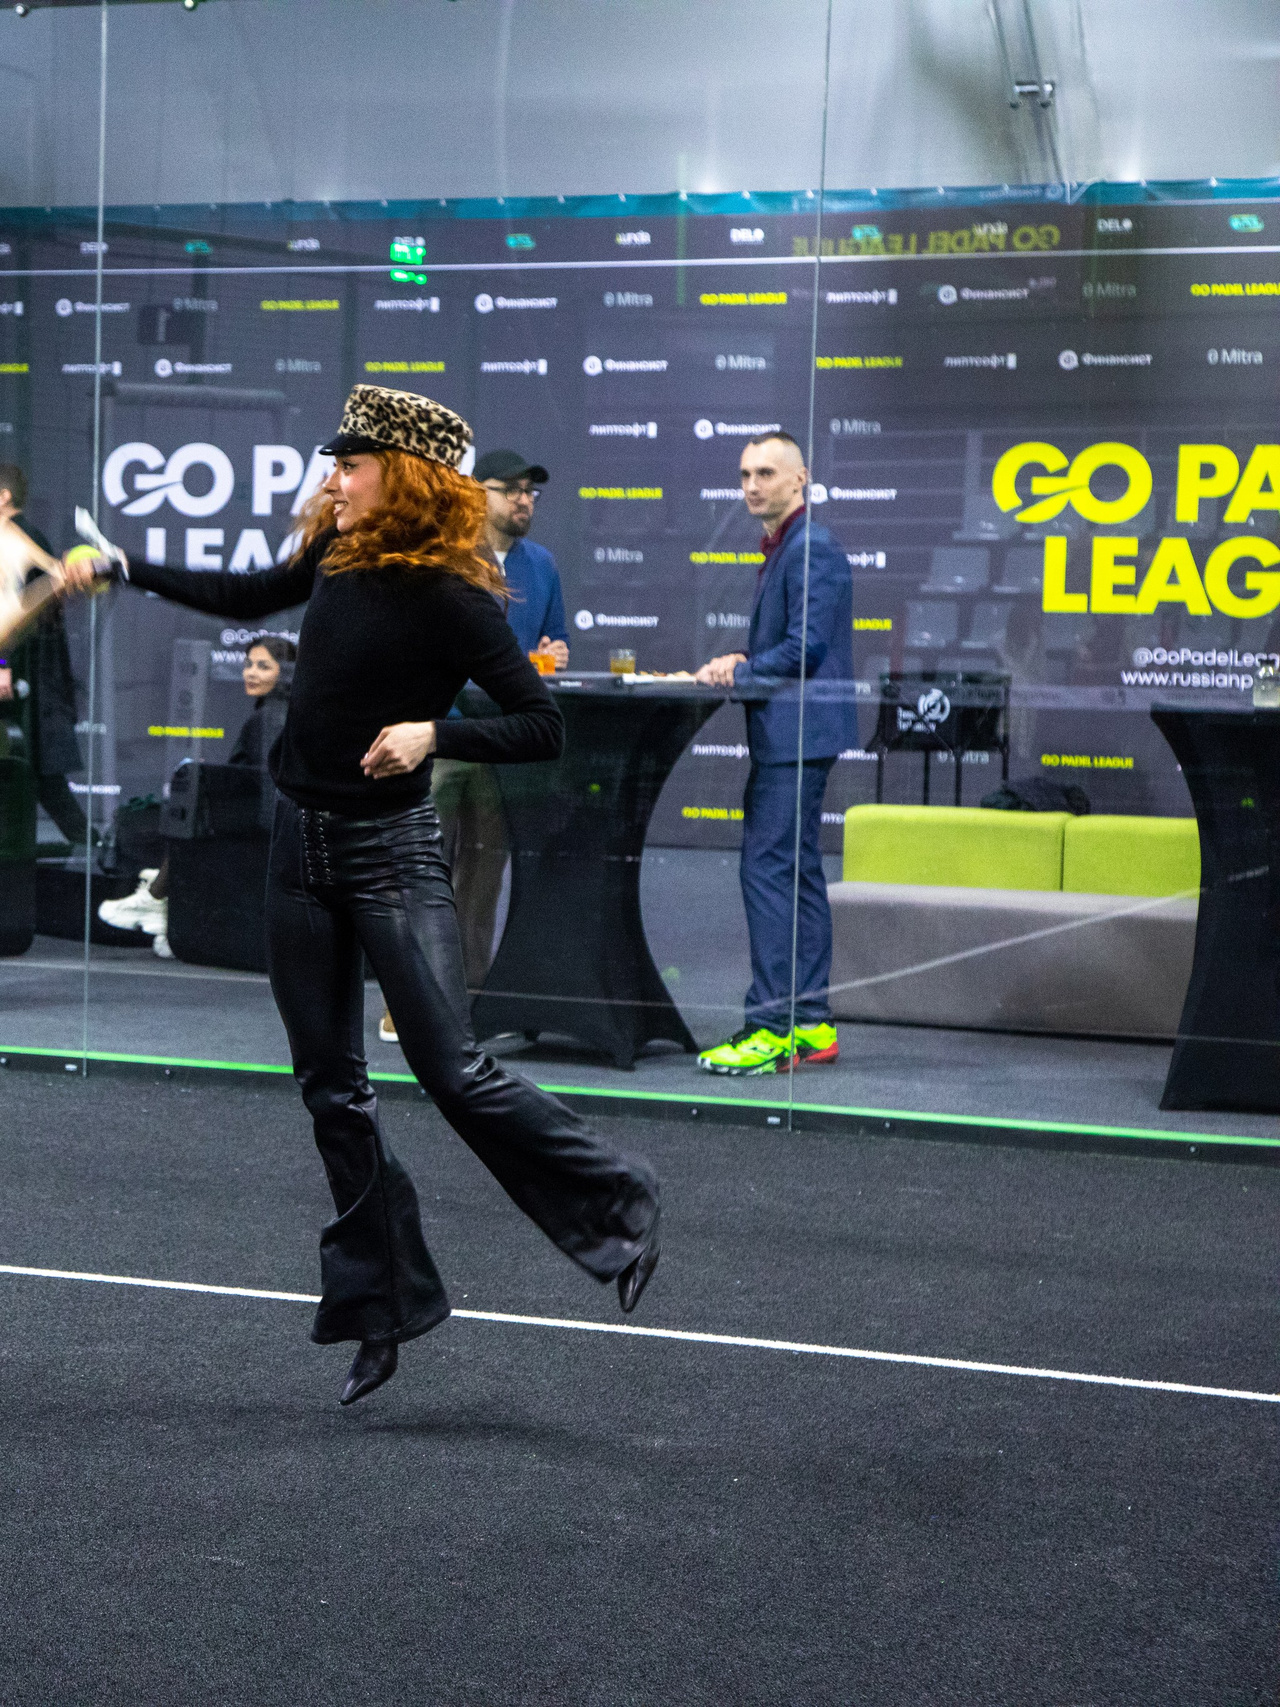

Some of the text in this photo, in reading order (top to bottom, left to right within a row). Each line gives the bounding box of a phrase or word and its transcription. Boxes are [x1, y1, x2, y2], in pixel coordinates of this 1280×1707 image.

[727, 354, 767, 370] Mitra
[1221, 348, 1263, 365] Mitra
[102, 442, 235, 517] GO
[992, 441, 1280, 524] GO PA
[738, 551, 766, 565] LEAG
[1041, 536, 1280, 618] LEAG
[718, 612, 751, 628] Mitr
[1041, 754, 1134, 769] GO PADEL LEAGUE
